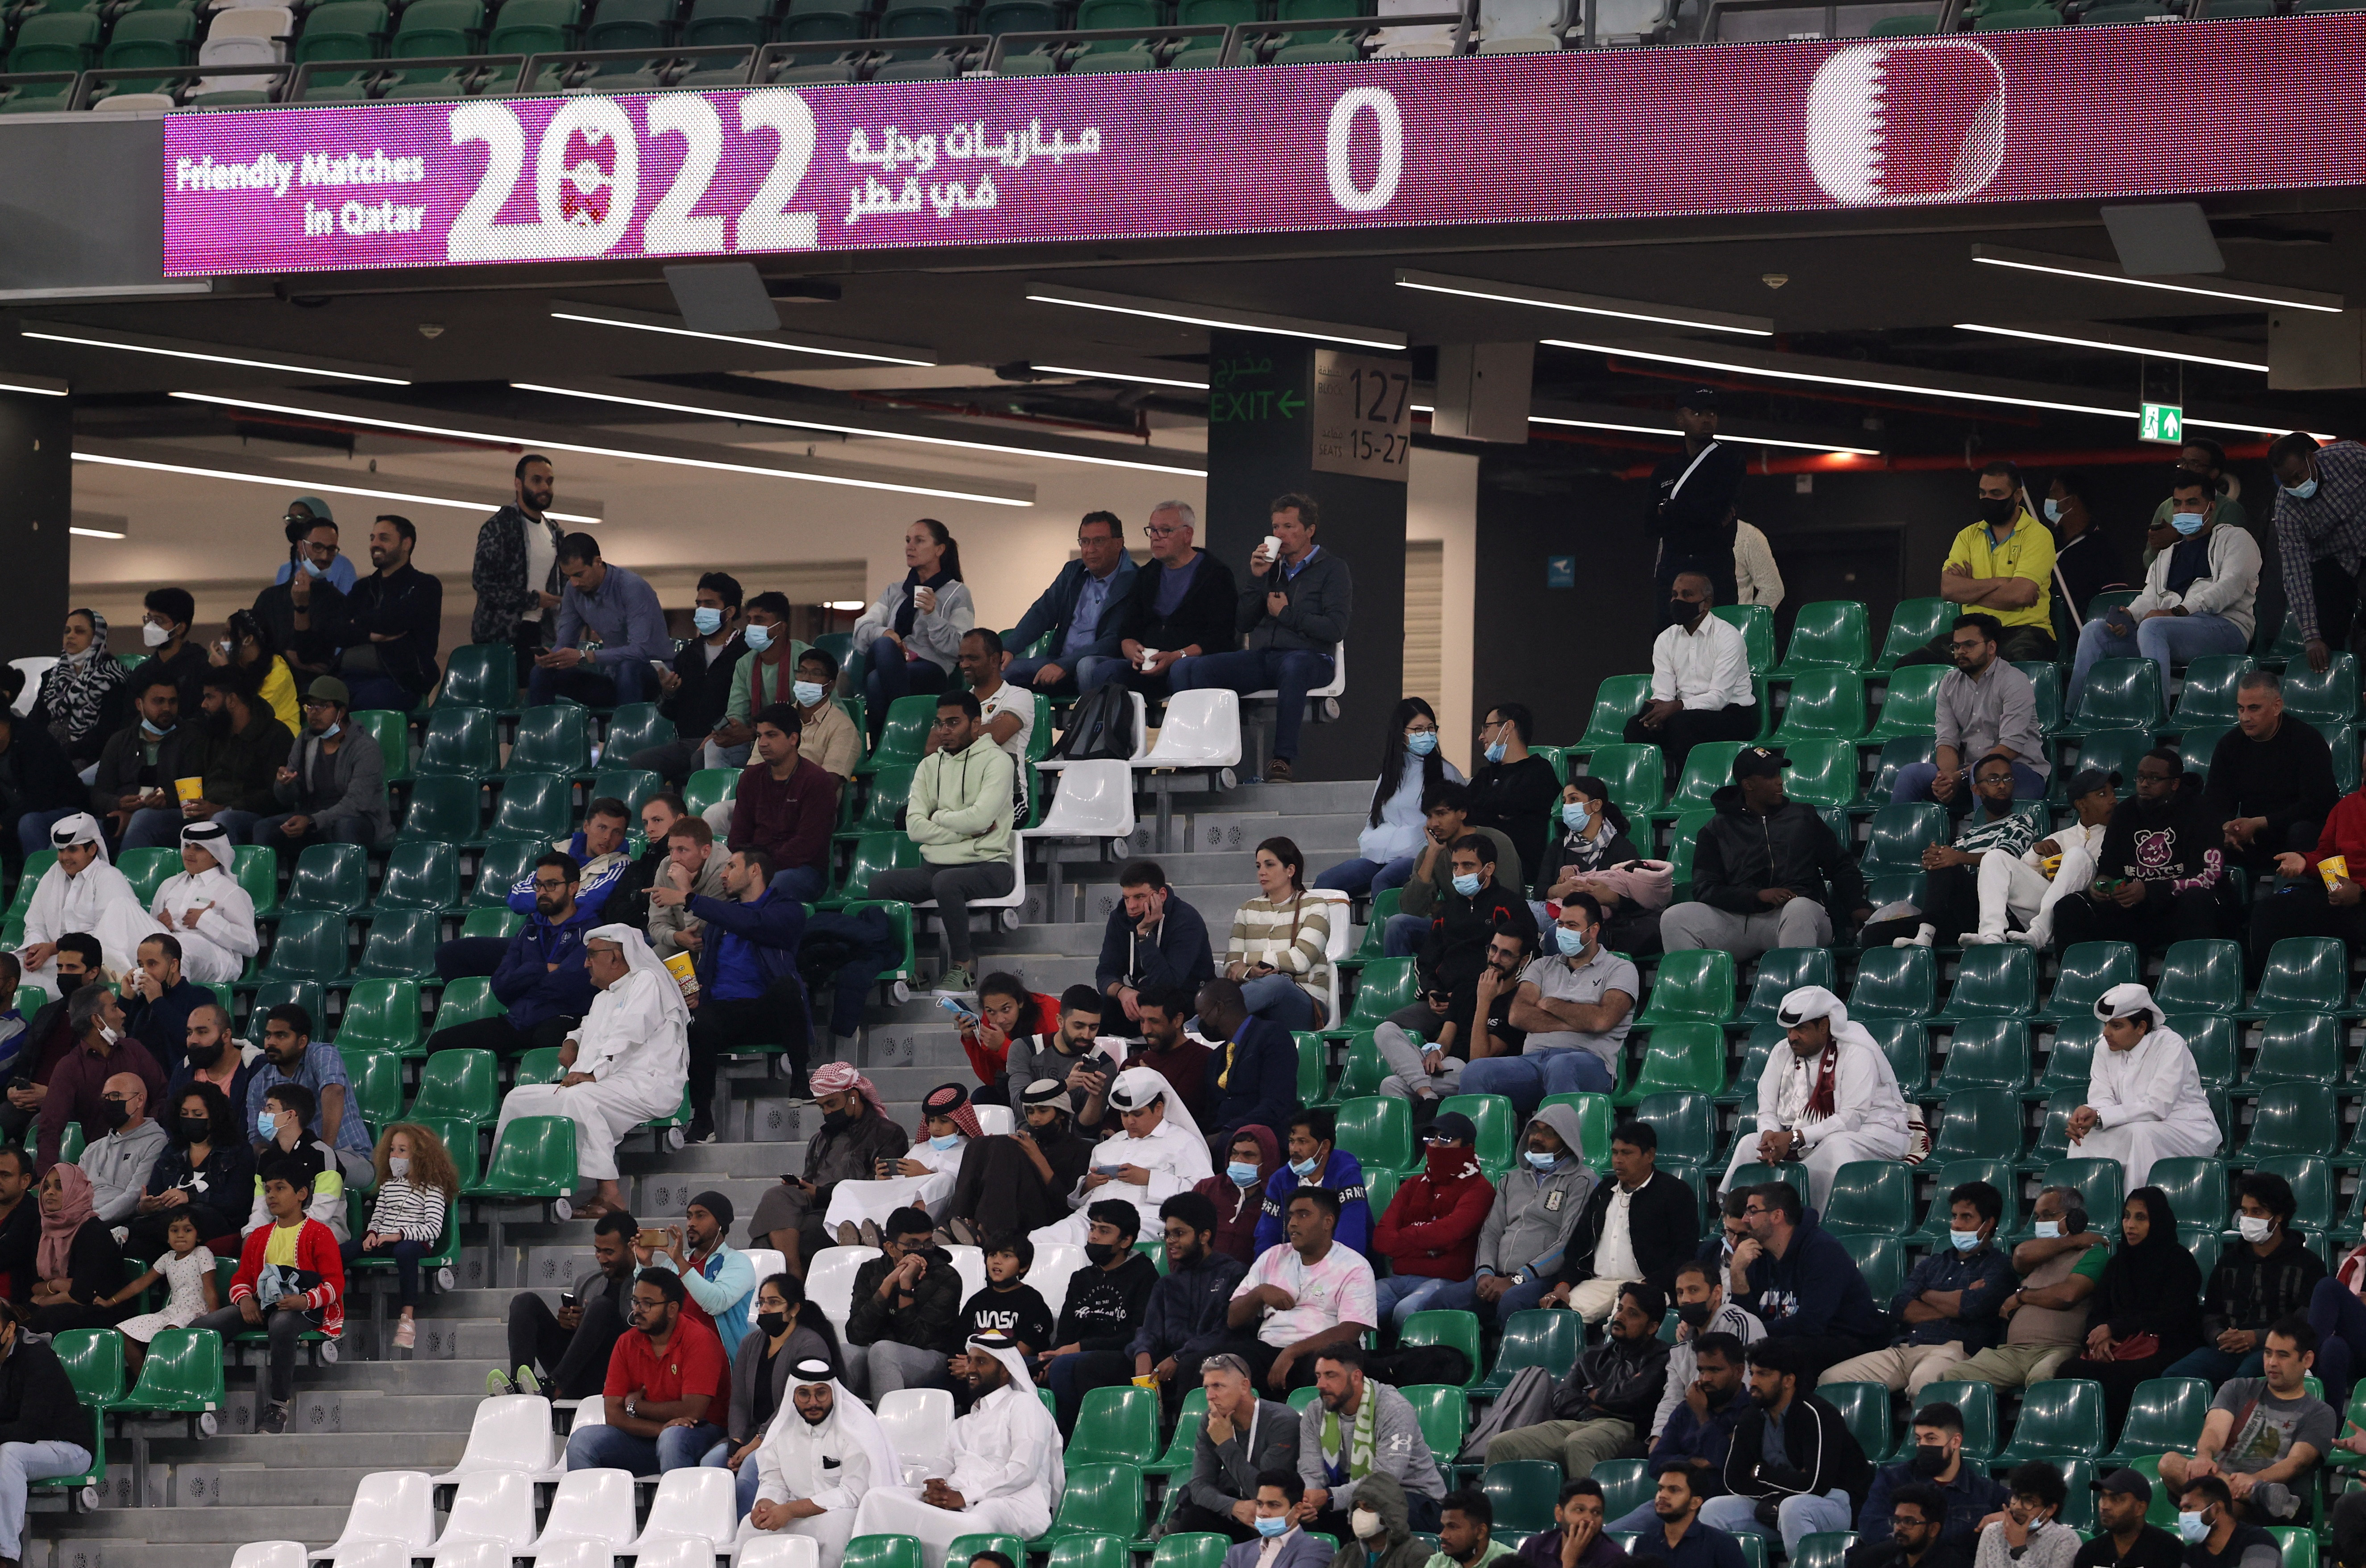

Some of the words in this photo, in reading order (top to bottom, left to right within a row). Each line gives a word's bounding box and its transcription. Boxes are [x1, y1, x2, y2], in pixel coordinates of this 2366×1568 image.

[944, 119, 1101, 168] مباريات
[1327, 87, 1402, 212] 0
[177, 152, 295, 198] Friendly
[300, 149, 425, 186] Matches
[447, 88, 819, 261] 2022
[305, 202, 333, 236] in
[340, 199, 425, 236] Qatar
[845, 176, 922, 225] قطر
[930, 174, 998, 218] في
[1214, 353, 1273, 389] مخرج
[1211, 390, 1275, 422] EXIT
[1318, 382, 1343, 396] BLOCK
[1350, 368, 1410, 424] 127
[1319, 444, 1342, 457] SEATS
[1351, 429, 1409, 464] 15-27
[678, 974, 692, 985] CORN
[974, 1310, 1019, 1329] NASA
